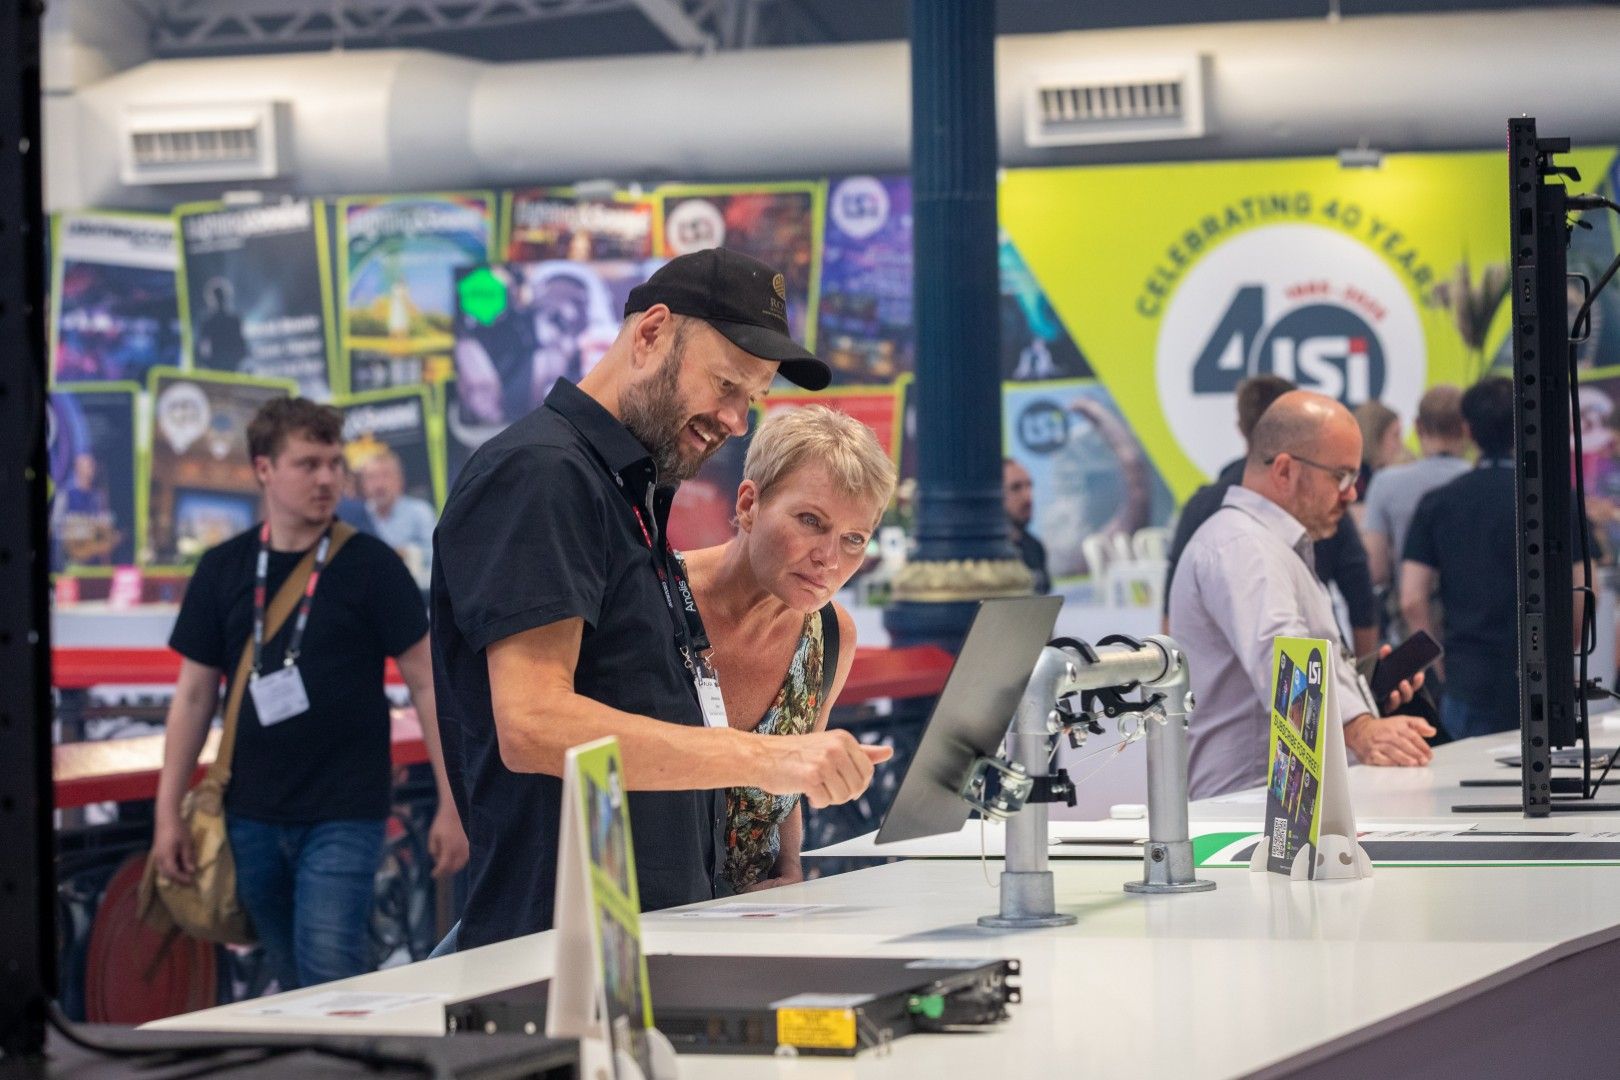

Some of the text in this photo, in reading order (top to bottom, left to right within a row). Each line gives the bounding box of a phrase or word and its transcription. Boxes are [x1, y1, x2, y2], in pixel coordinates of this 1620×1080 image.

[1135, 193, 1312, 318] CELEBRATING
[1323, 200, 1362, 228] 40
[678, 580, 697, 612] Anolis
